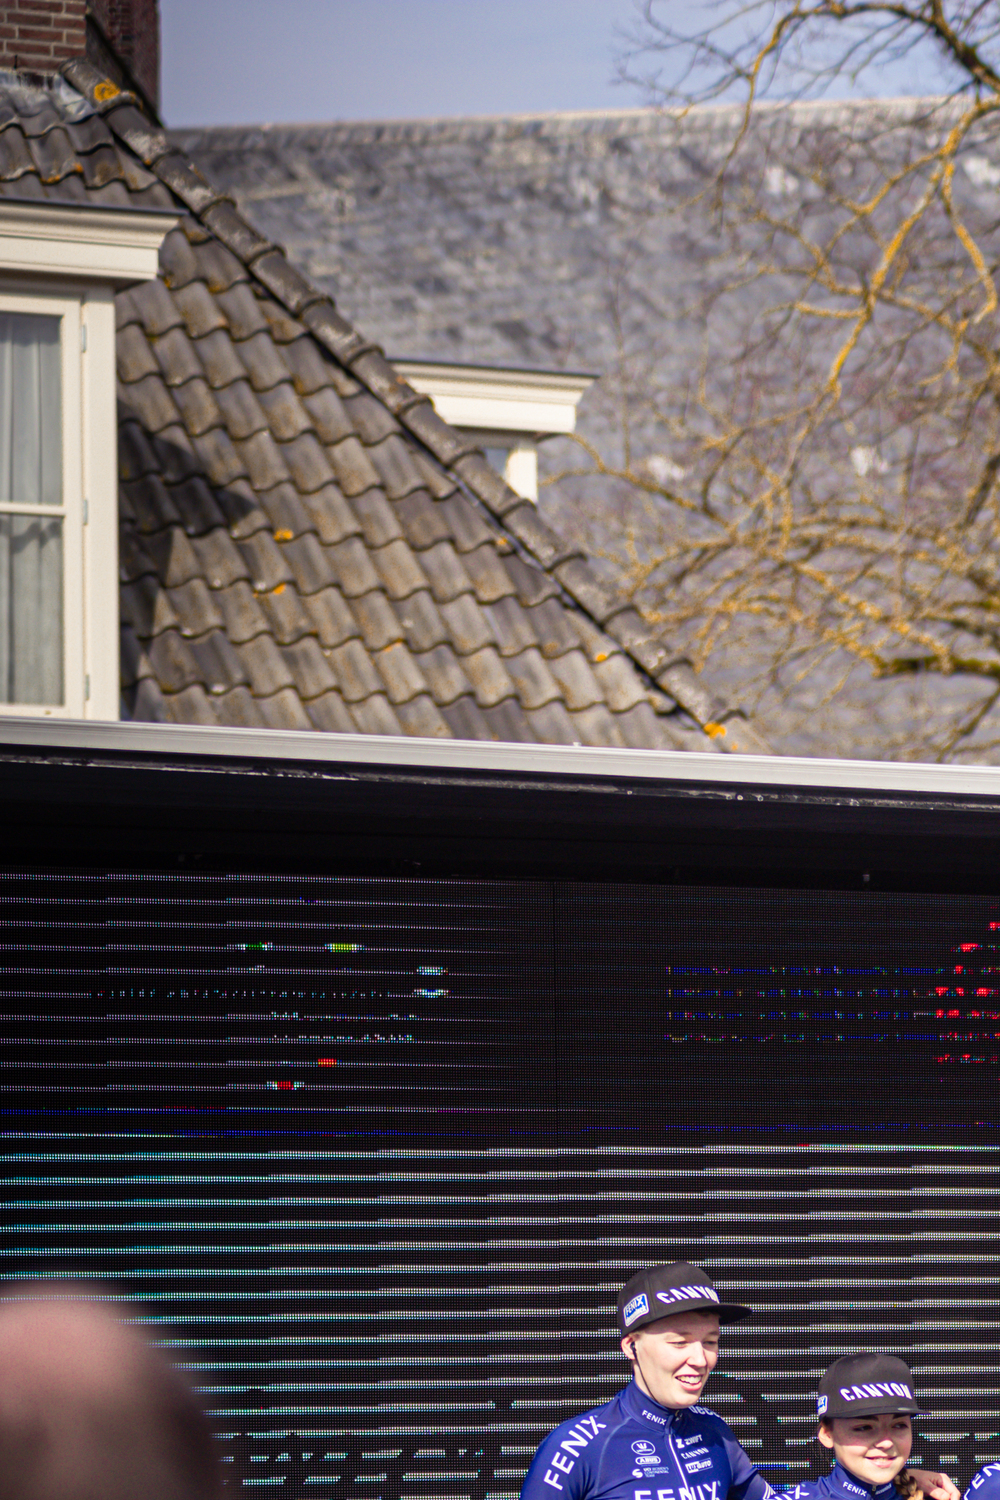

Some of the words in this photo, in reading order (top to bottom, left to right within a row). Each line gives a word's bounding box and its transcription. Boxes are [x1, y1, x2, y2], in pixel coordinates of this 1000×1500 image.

[839, 1383, 913, 1401] CANYON
[642, 1409, 667, 1426] FENIX
[543, 1415, 607, 1490] FENIX
[842, 1481, 868, 1497] FENIX
